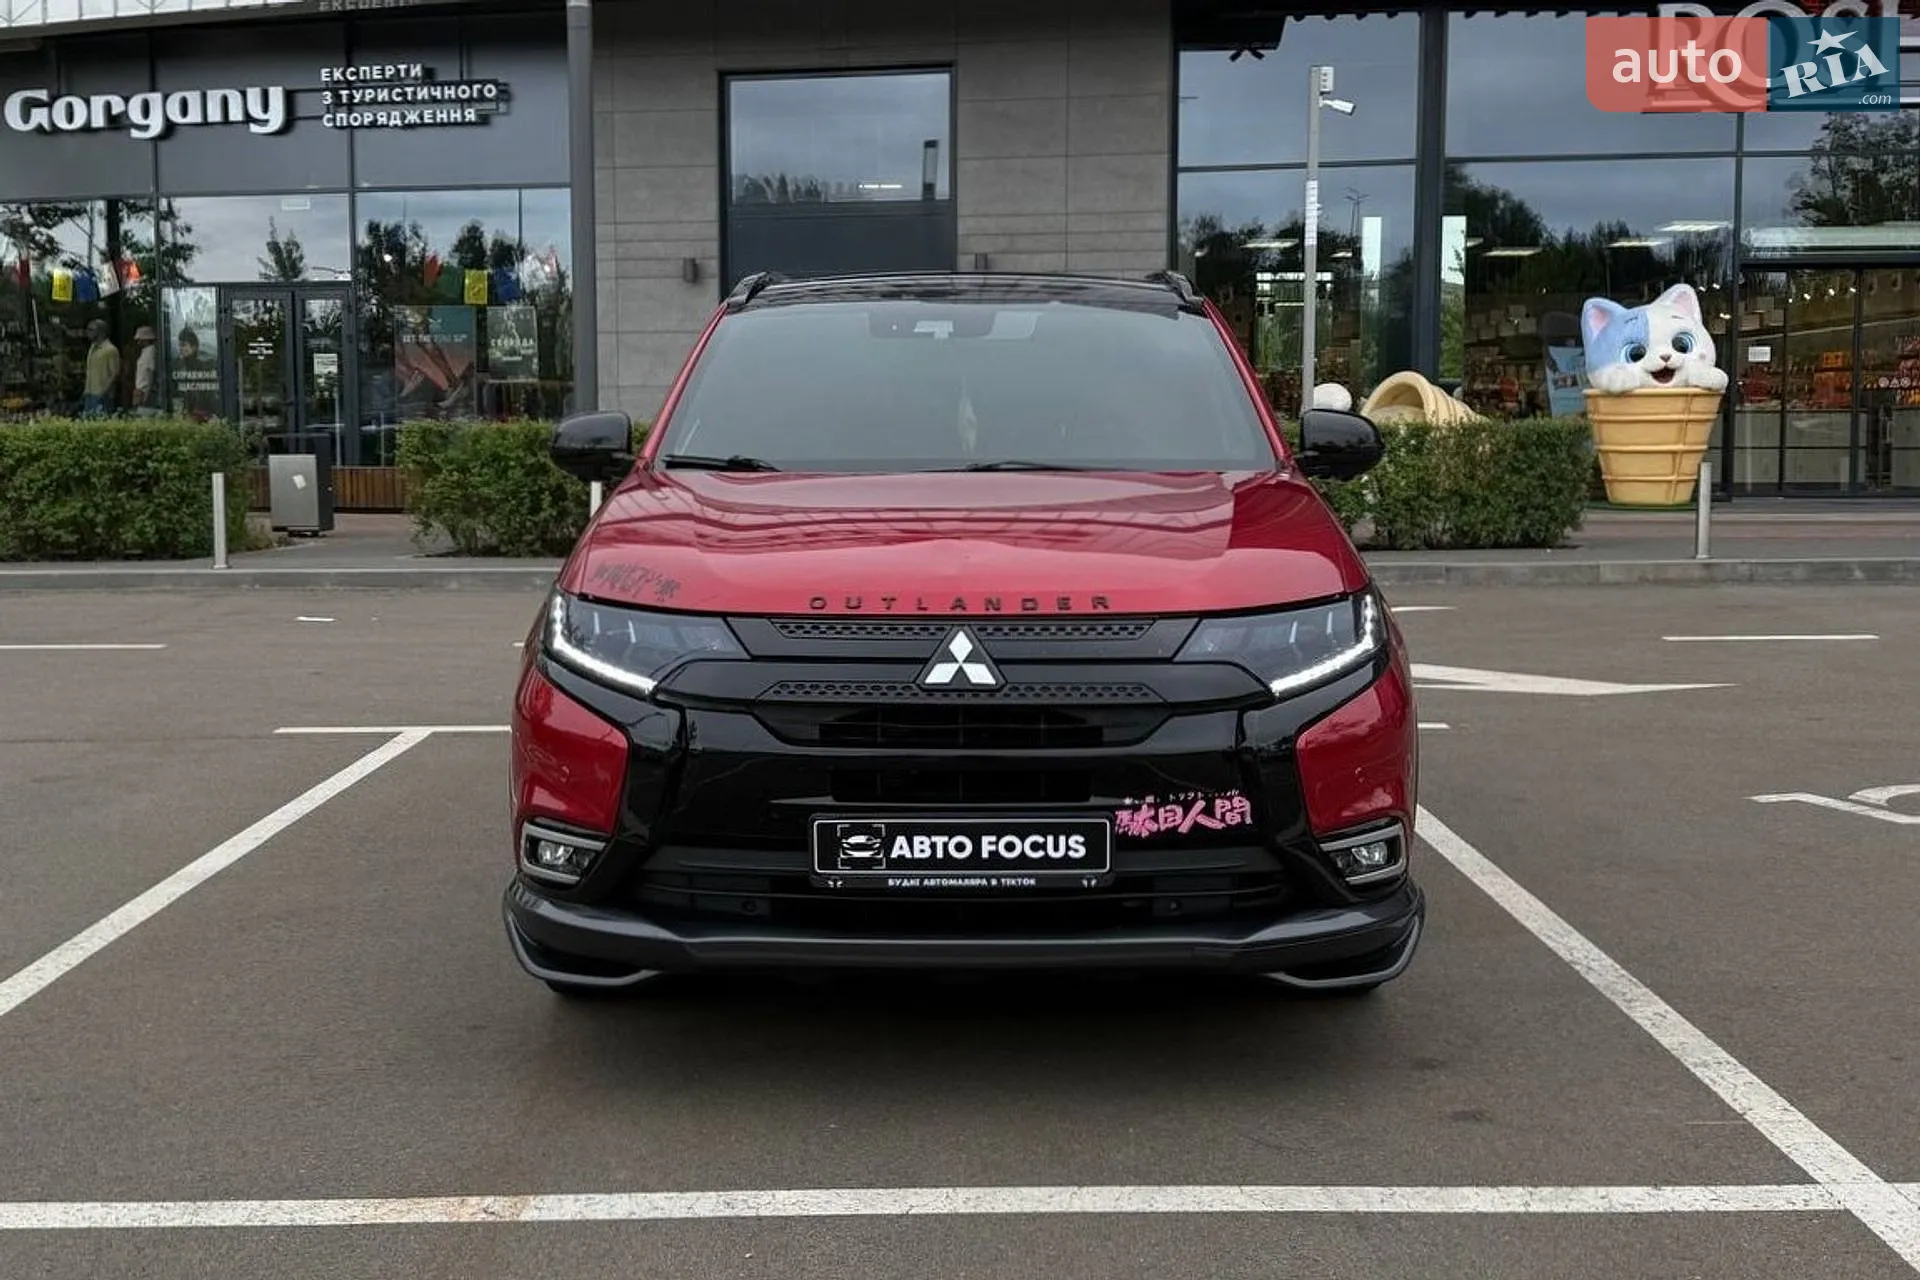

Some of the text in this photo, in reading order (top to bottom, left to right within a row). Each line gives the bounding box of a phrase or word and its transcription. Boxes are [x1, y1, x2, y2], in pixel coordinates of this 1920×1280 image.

[320, 63, 423, 82] ЕКСПЕРТИ
[322, 83, 498, 105] З ТУРИСТИЧНОГО
[3, 86, 287, 139] Gorgany
[322, 107, 477, 128] СПОРЯДЖЕННЯ
[809, 595, 1111, 612] OUTLANDER
[981, 835, 1087, 860] FOCUS
